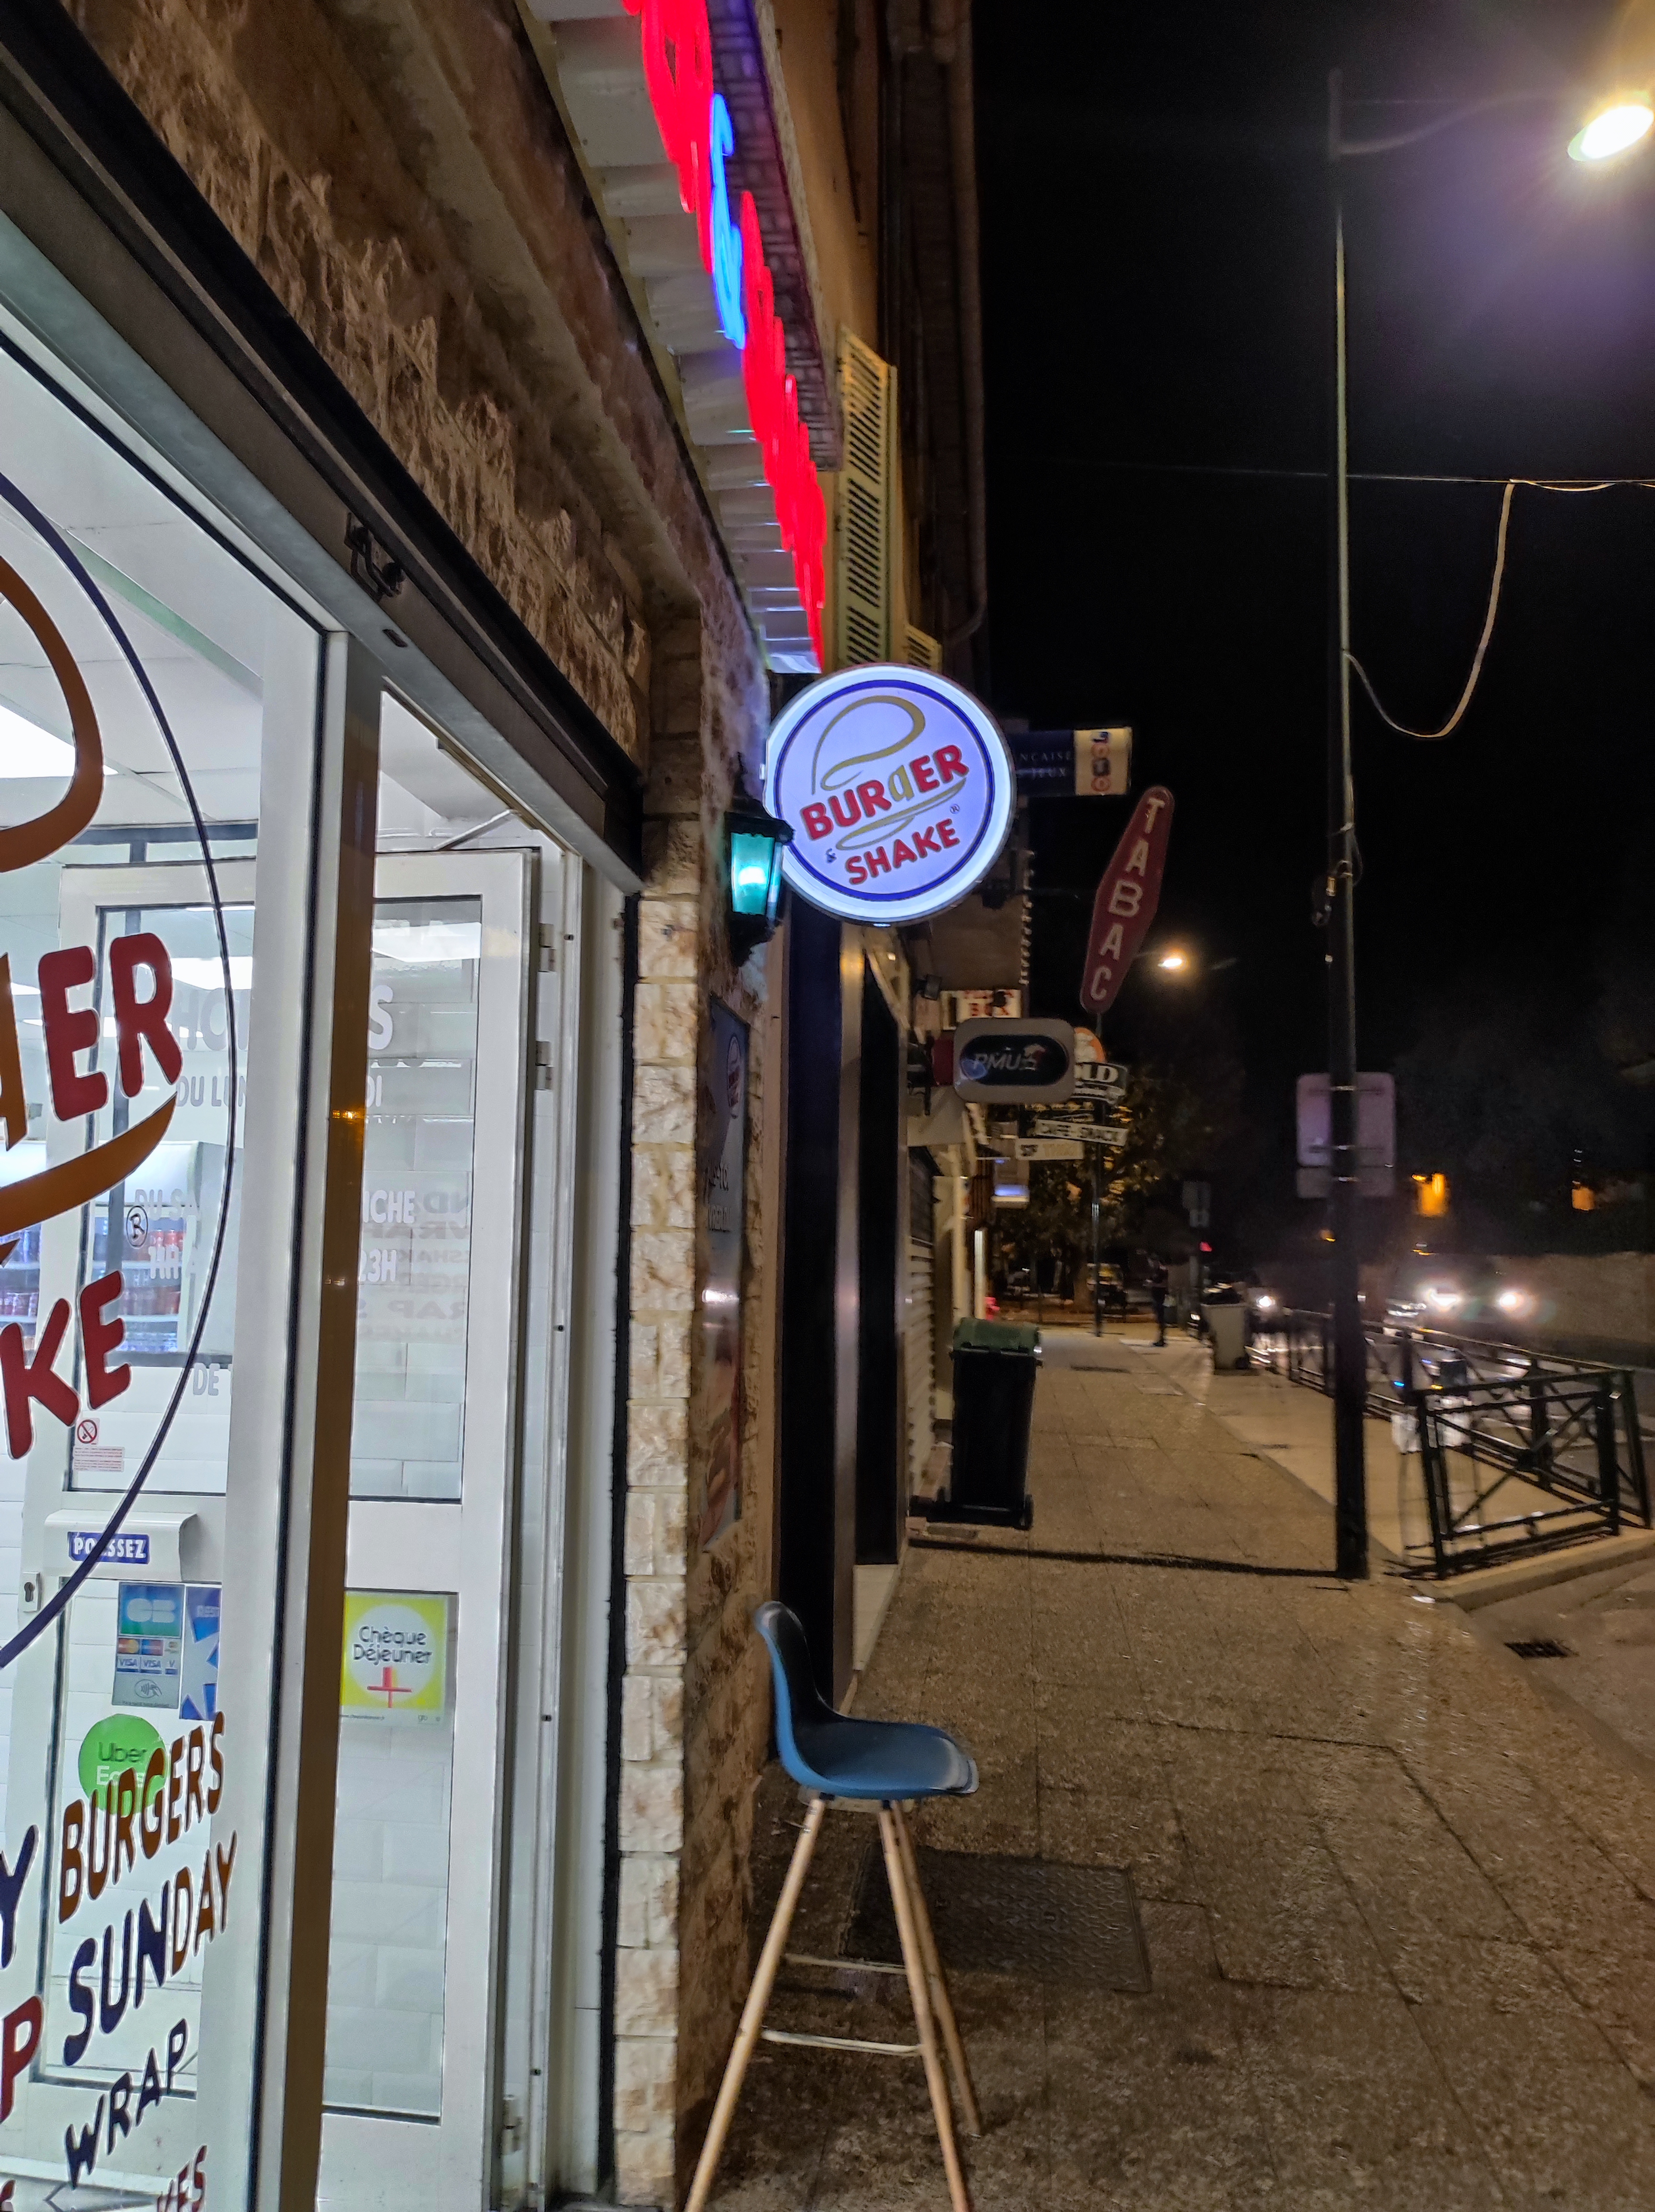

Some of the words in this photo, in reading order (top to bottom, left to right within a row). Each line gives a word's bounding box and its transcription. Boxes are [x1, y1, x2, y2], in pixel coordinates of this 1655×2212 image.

[845, 818, 961, 885] SHAKE
[1090, 798, 1165, 1001] TABAC
[972, 1052, 1021, 1070] PMU
[192, 1362, 221, 1396] DE
[73, 1536, 147, 1559] POSSEZ
[358, 1626, 427, 1648] Chèque
[119, 1658, 138, 1667] VISA
[143, 1659, 162, 1669] VISA
[353, 1643, 432, 1665] Déjeuner
[98, 1742, 148, 1763] Uber
[96, 1765, 146, 1788] Eas
[58, 1710, 225, 1924] BURGERS
[63, 1829, 237, 2067] SUNDAY
[64, 2017, 189, 2190] WRAP
